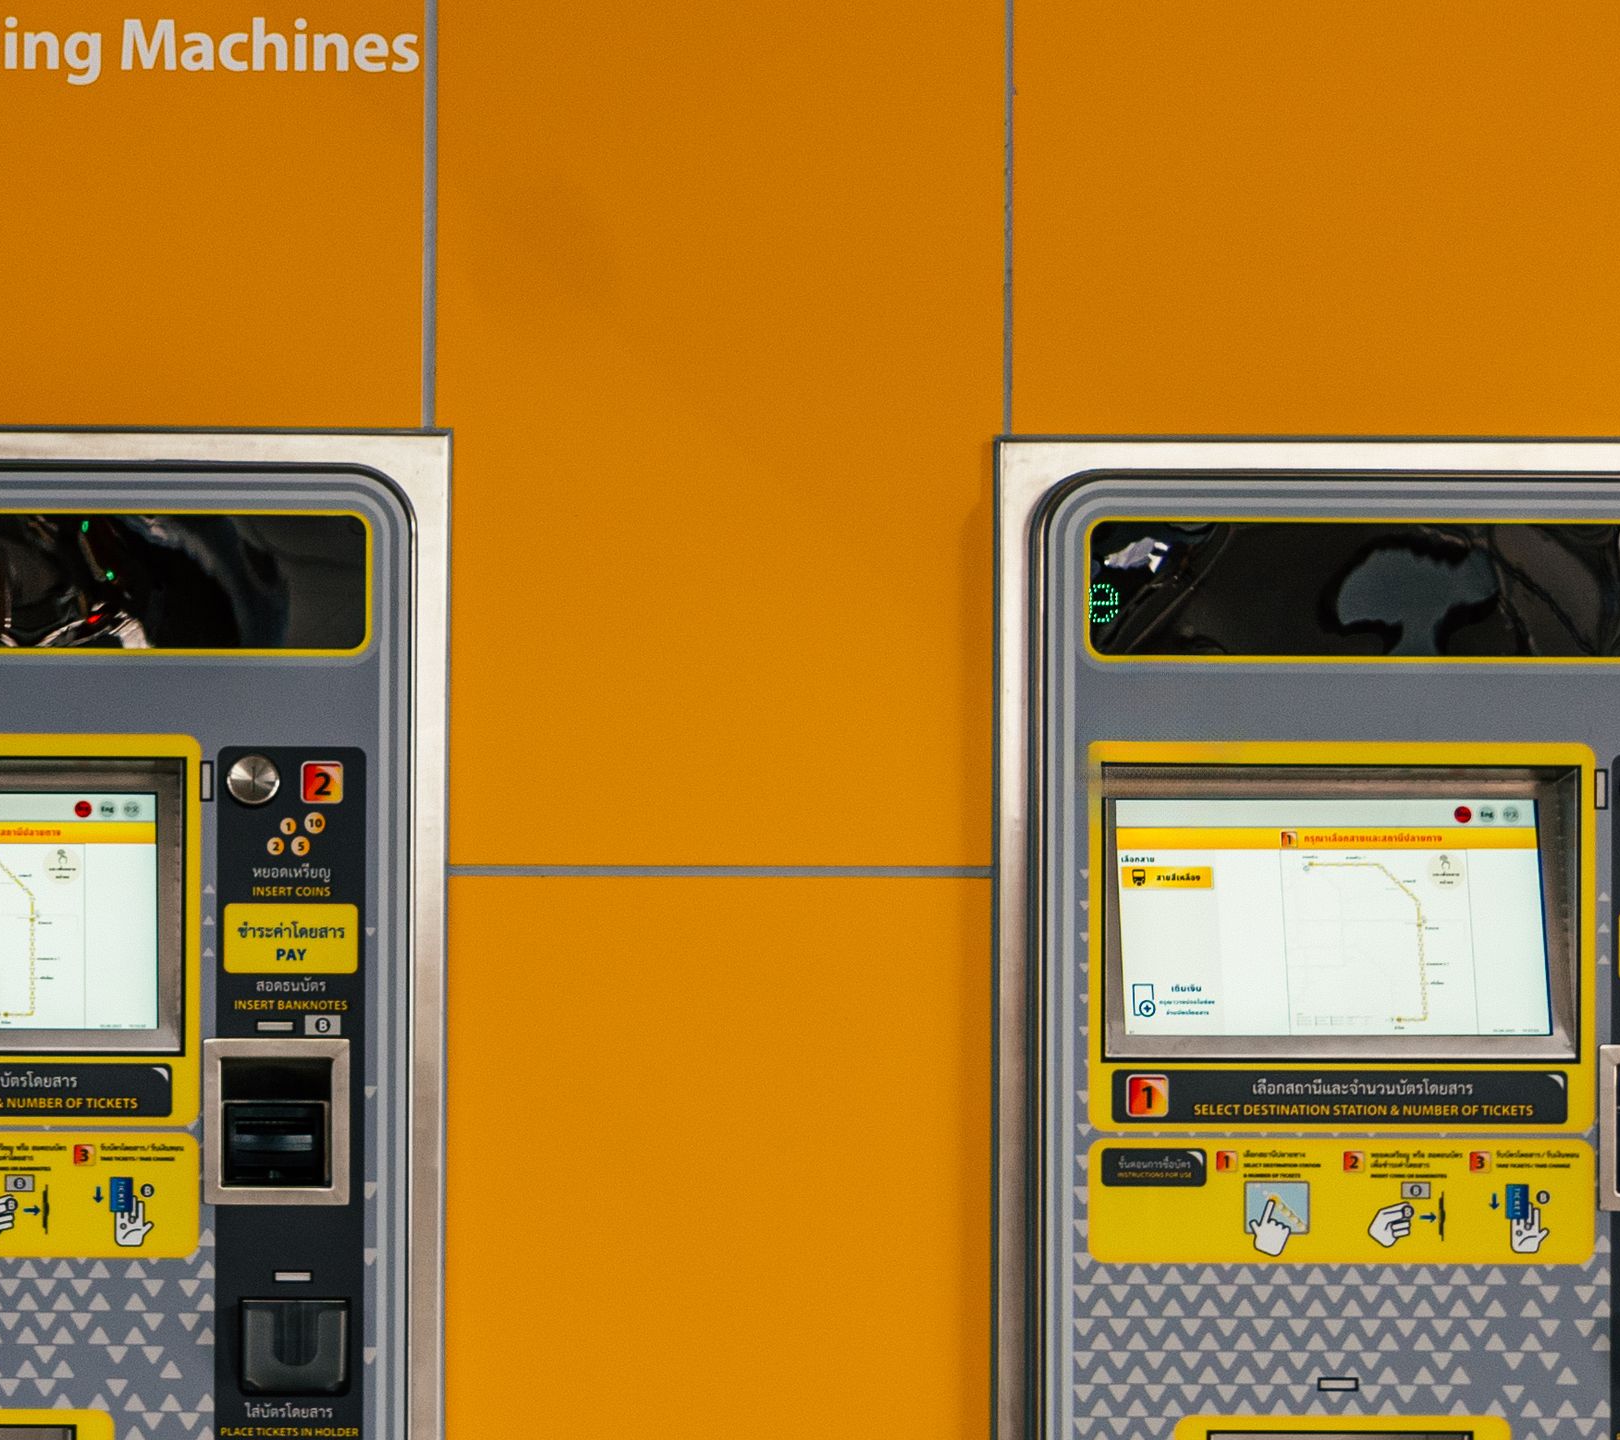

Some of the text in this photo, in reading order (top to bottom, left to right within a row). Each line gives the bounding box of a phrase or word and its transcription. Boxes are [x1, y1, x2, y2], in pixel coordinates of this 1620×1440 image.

[120, 18, 419, 74] Machines
[314, 773, 331, 796] 2
[100, 805, 115, 814] Eng
[252, 865, 332, 883] หยอดเหรียญ
[252, 887, 331, 897] INSERT COINS
[237, 921, 345, 939] ชำระค่าโดยสาร
[275, 949, 307, 962] PAY
[256, 977, 326, 992] สอดธนบัตร
[234, 1000, 348, 1011] INSERT BANKNOTES
[1250, 1077, 1474, 1097] เลือกสถานีและจำนวนบัตรโดยสาร
[6, 1098, 63, 1109] NUMBER
[66, 1098, 84, 1109] OF
[86, 1098, 139, 1110] TICKETS
[1141, 1084, 1154, 1109] 1
[1194, 1103, 1535, 1117] SELECT DESTINATION STATION & NUMBER OF TICKETS
[79, 1149, 90, 1164] 3
[1348, 1156, 1360, 1171] 2
[1474, 1156, 1485, 1171] 3
[243, 1401, 334, 1418] ใส่บัตรโดยสาร
[219, 1426, 359, 1437] PLACE TICKETS IN HOLDER
